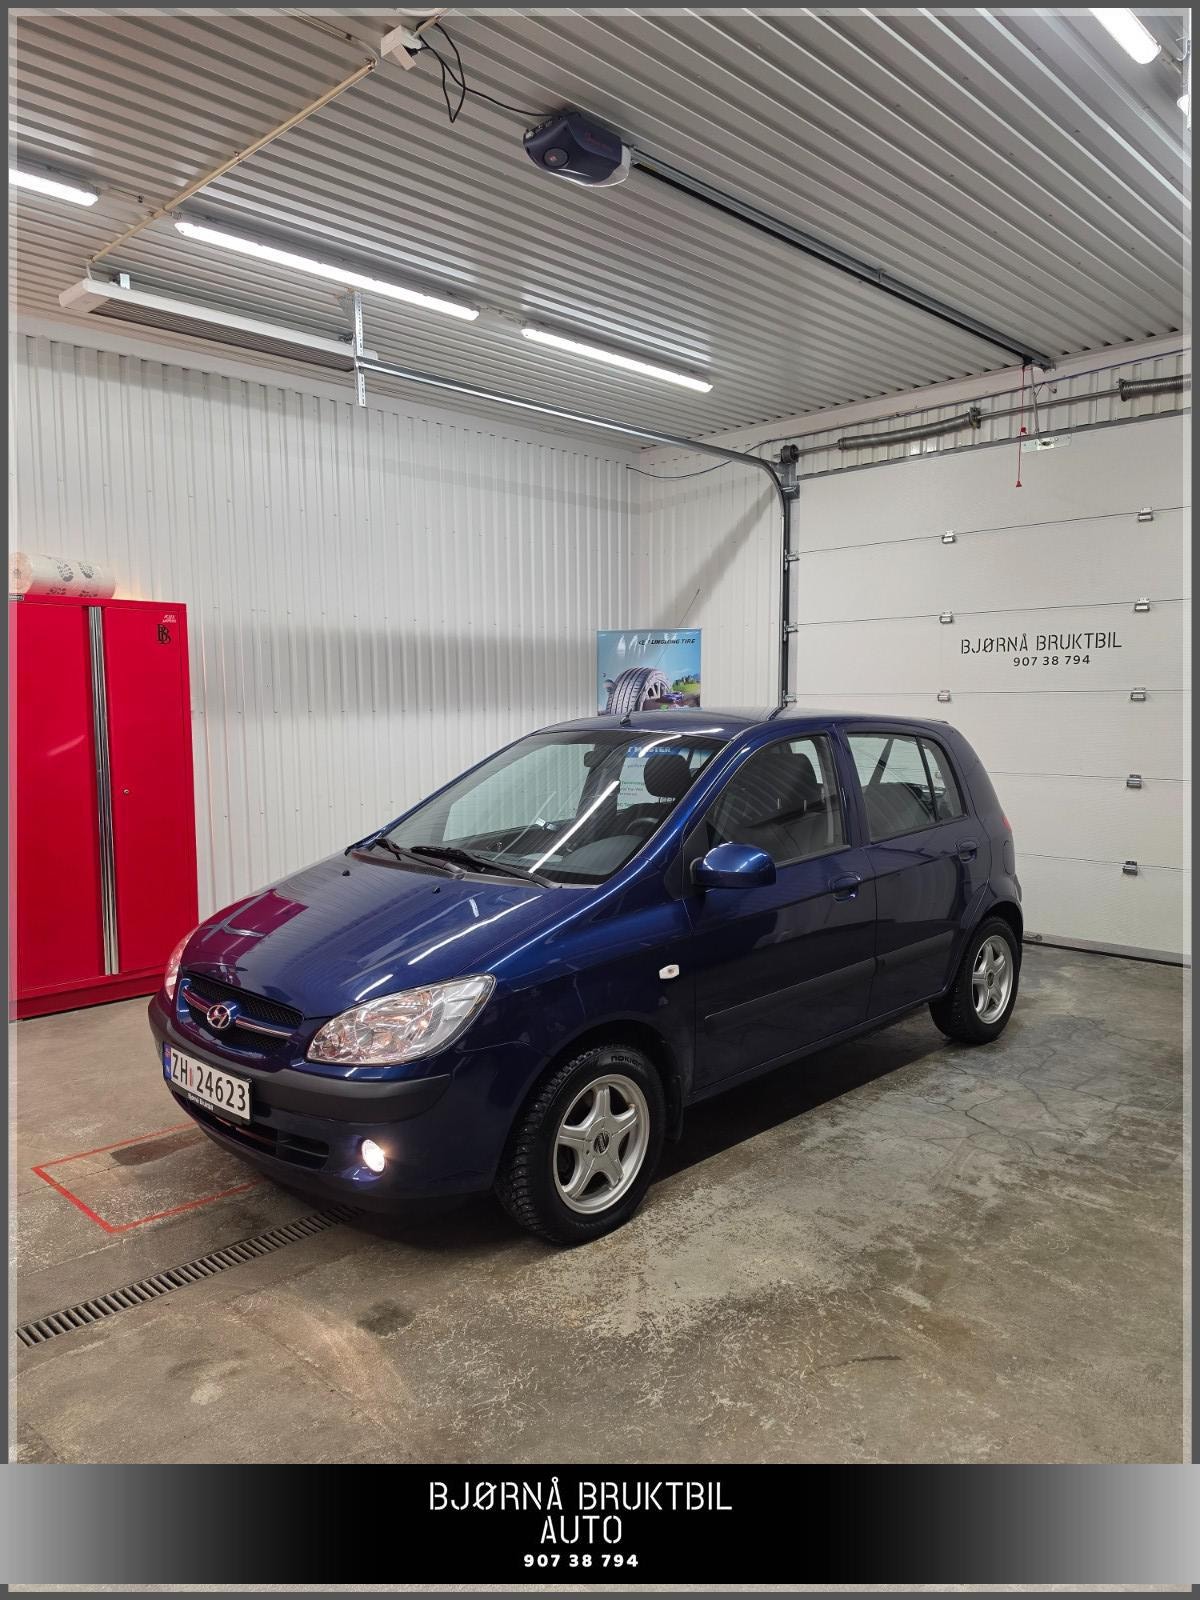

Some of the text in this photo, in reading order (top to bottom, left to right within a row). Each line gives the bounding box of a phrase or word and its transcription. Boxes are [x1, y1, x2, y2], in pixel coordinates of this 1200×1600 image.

[961, 631, 1122, 654] BJØRNÅ BRUKTBIL
[1013, 655, 1091, 667] 907 38 794
[172, 1052, 188, 1086] ZH
[196, 1066, 246, 1112] 24623
